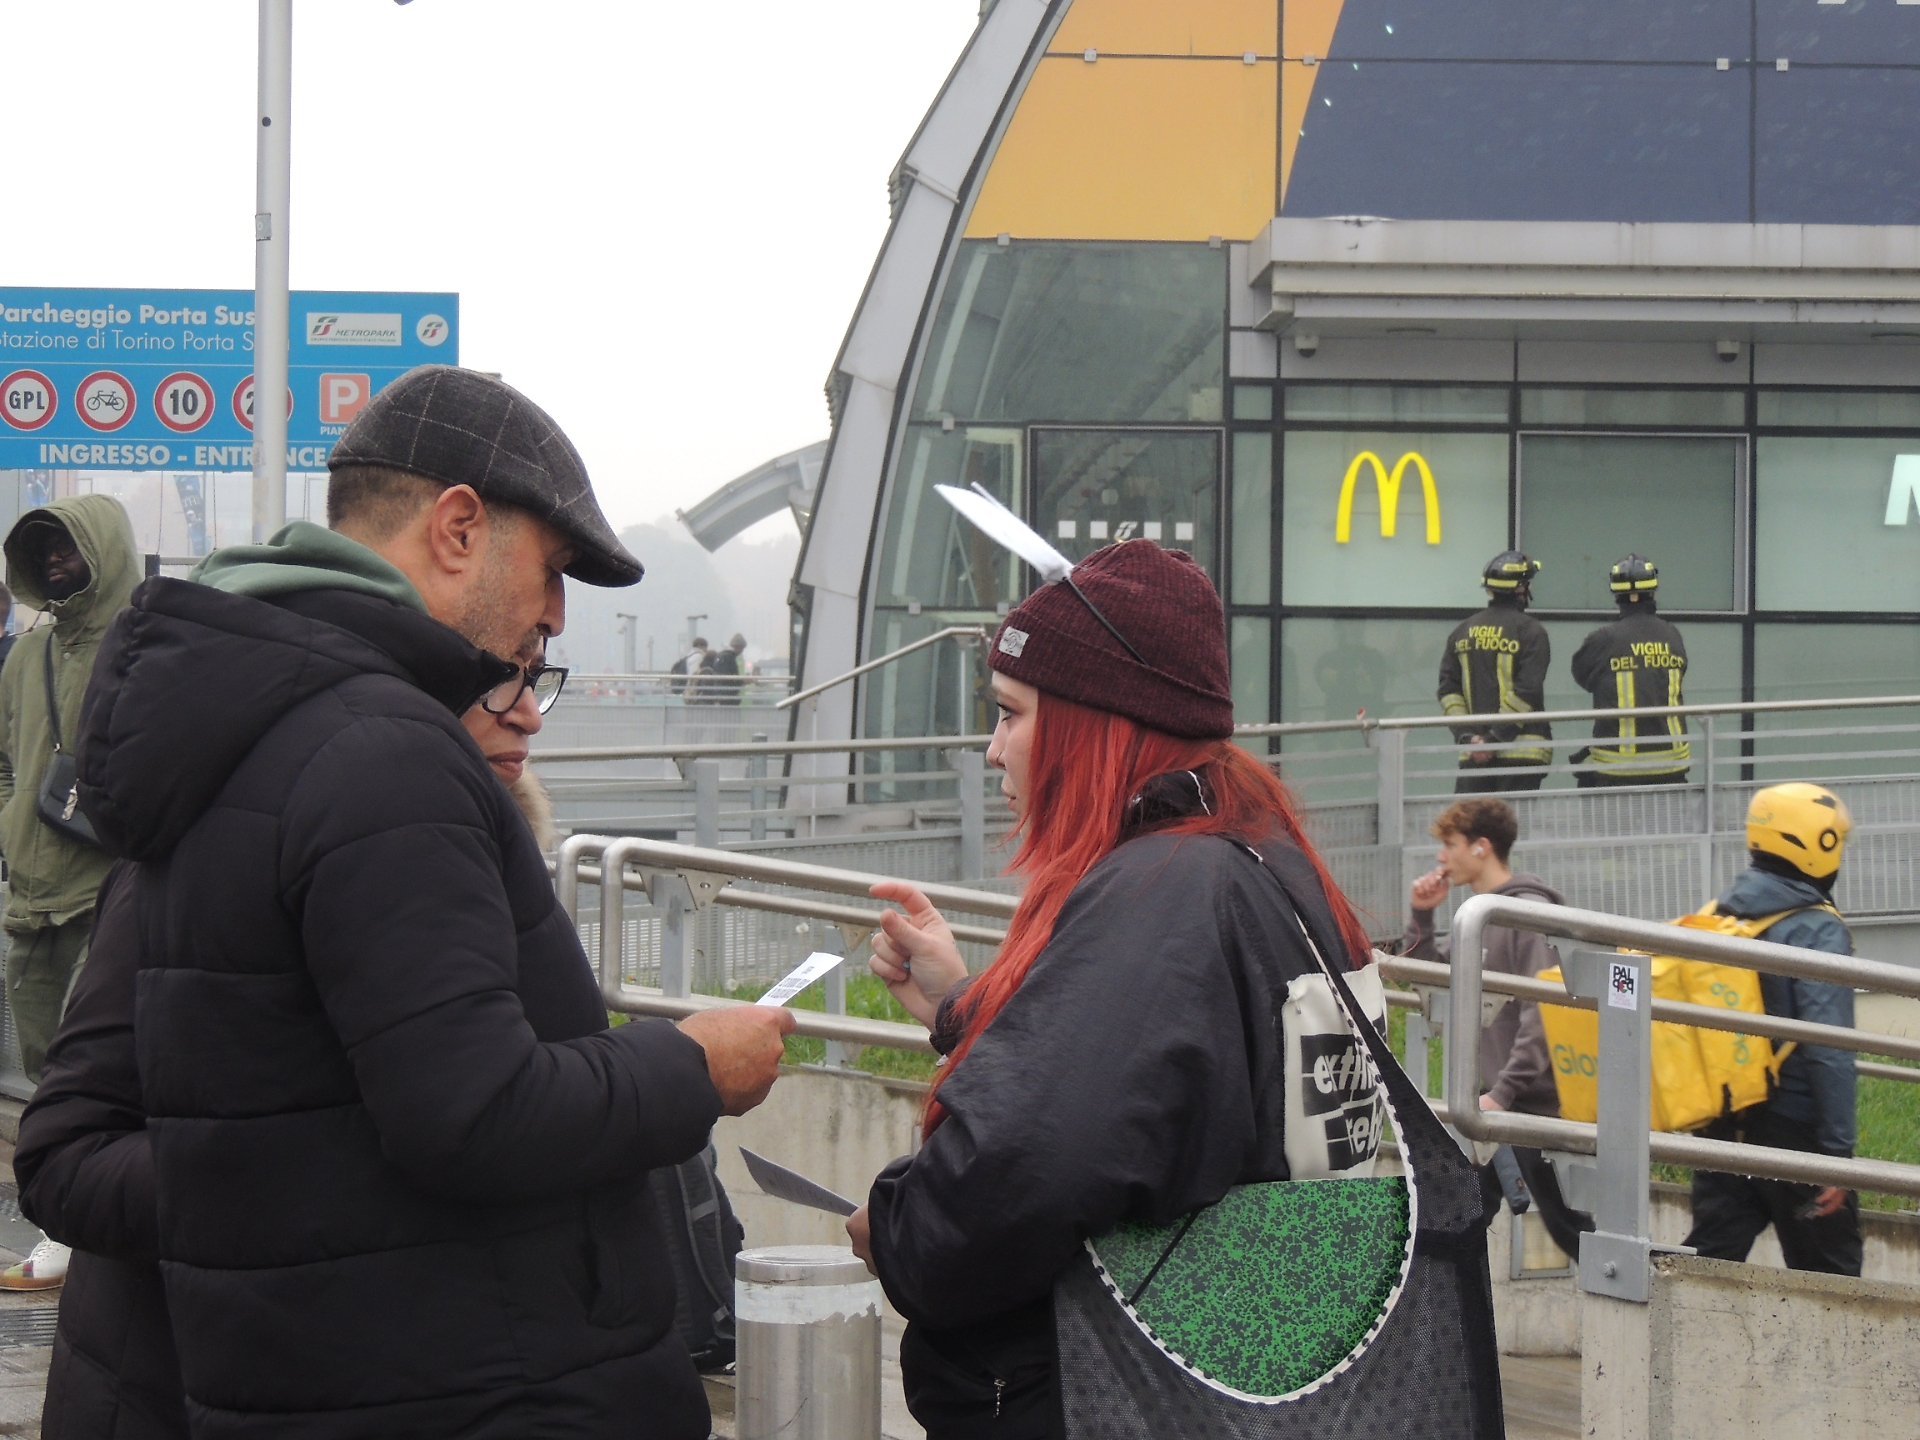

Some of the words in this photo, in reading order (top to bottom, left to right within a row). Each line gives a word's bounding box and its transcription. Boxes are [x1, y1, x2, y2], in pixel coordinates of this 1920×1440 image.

[140, 304, 207, 325] Porta
[215, 305, 255, 326] Sus
[0, 330, 79, 349] tazione
[87, 328, 105, 349] di
[111, 329, 175, 350] Torino
[183, 330, 234, 351] Porta
[335, 329, 397, 337] METROPARK
[9, 390, 45, 410] GPL
[169, 388, 199, 416] 10
[329, 379, 360, 418] P
[320, 426, 346, 436] PIAN
[40, 444, 171, 466] INGRESSO
[195, 445, 326, 468] ENTRNCE
[1469, 625, 1503, 638] VIGILI
[1475, 636, 1520, 653] FUOCO
[1630, 642, 1670, 656] VIGILI
[1610, 656, 1639, 671] DEL
[1553, 1044, 1598, 1078] Glo
